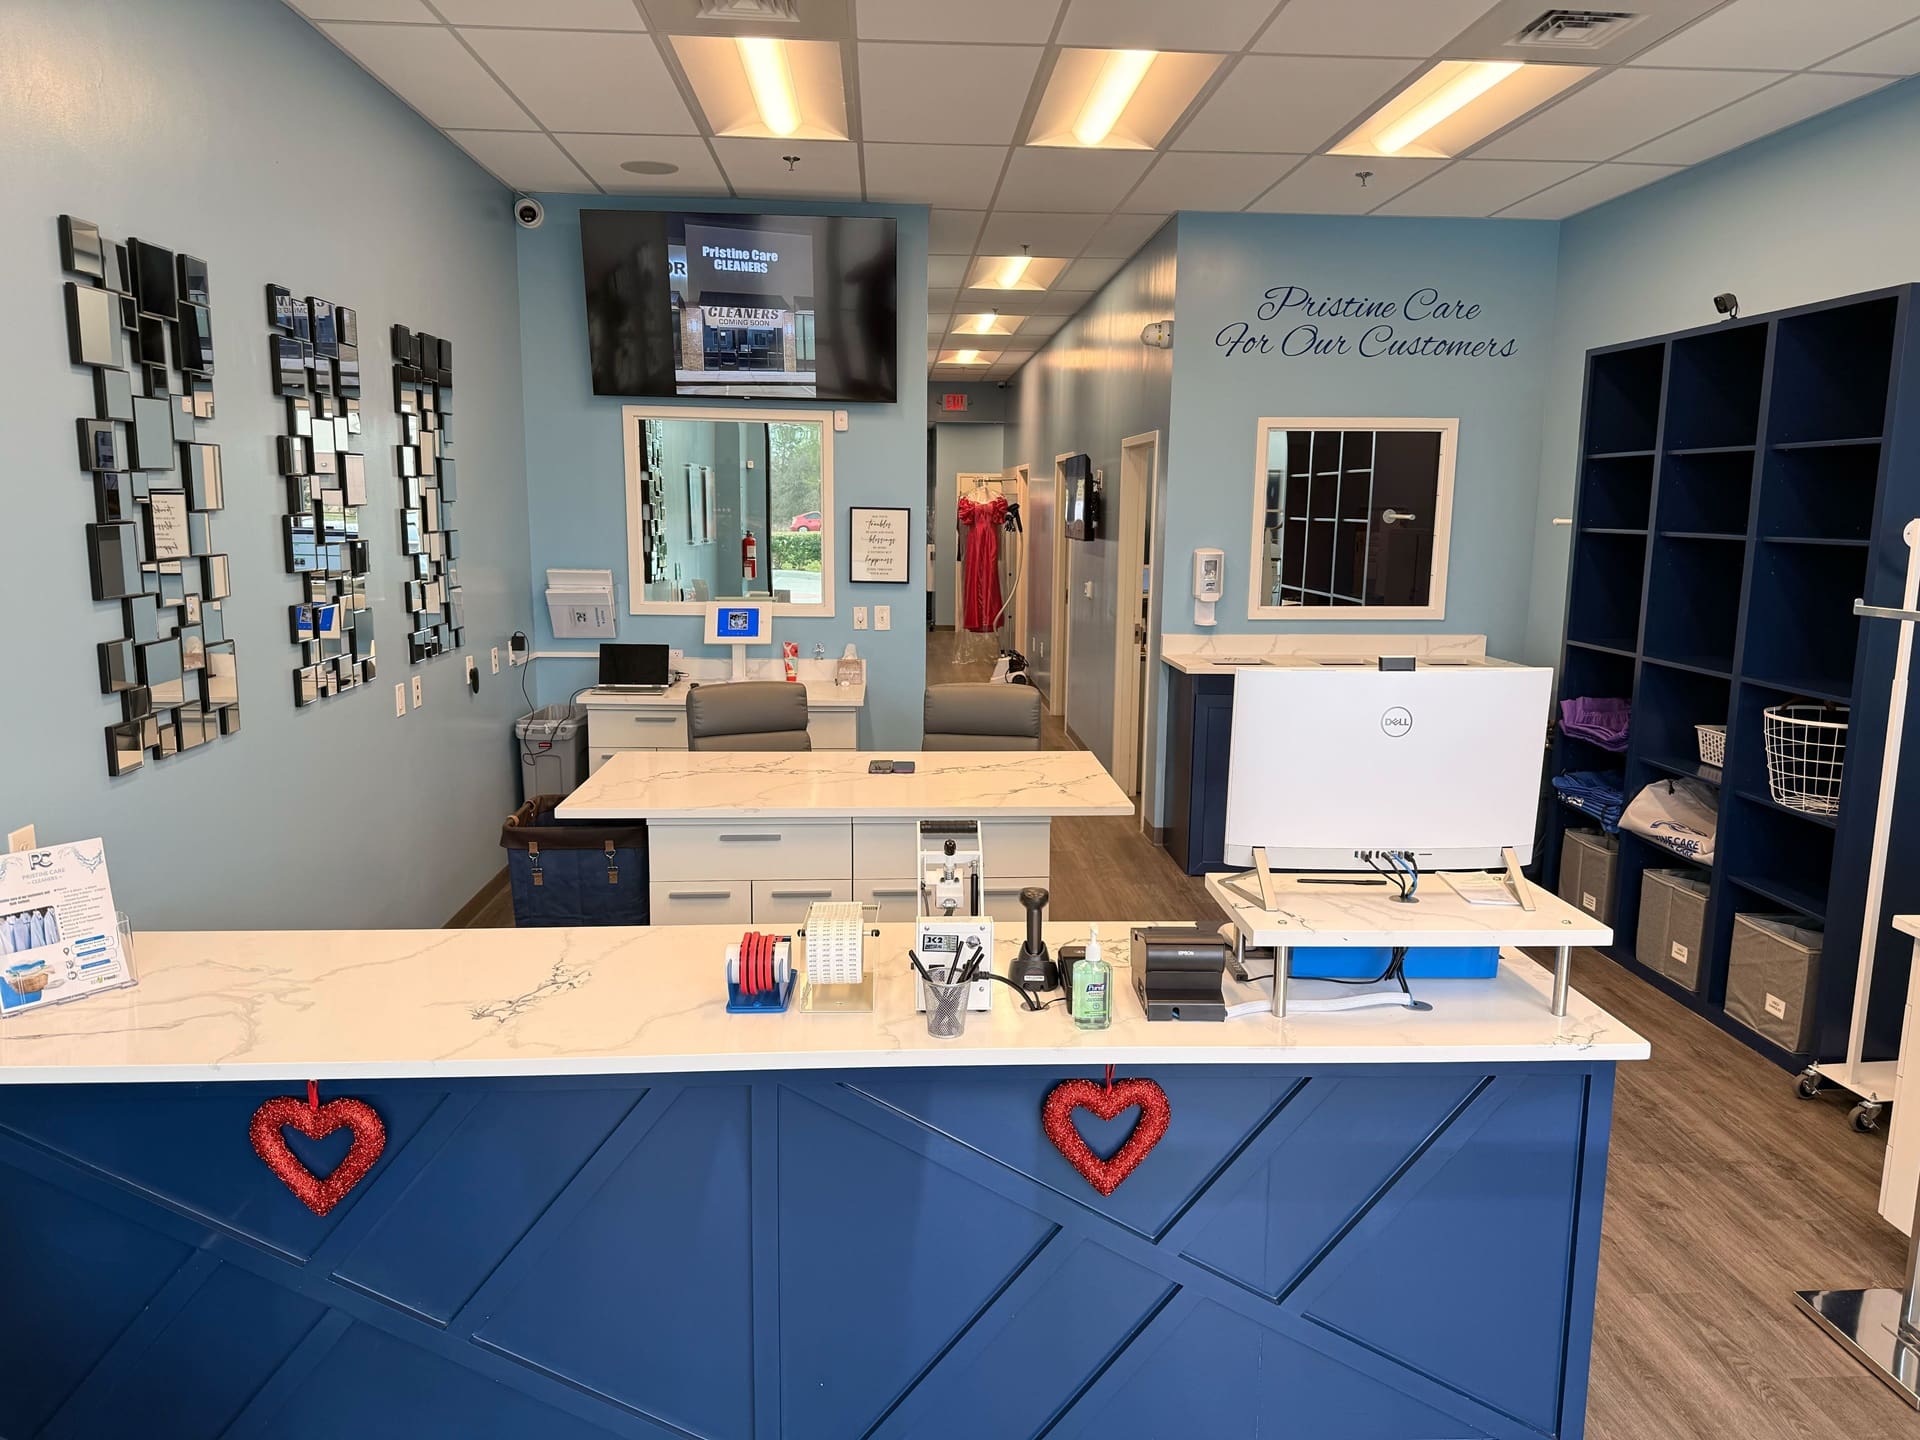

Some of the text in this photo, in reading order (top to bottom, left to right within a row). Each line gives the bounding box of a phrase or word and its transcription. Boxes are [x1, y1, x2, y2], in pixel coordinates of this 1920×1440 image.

[702, 246, 779, 262] Pristine Care
[714, 259, 768, 274] CLEANERS
[1257, 286, 1481, 321] Pristine Care
[709, 307, 779, 320] CLEANERS
[718, 318, 770, 327] COMING SOON
[1215, 322, 1518, 358] For Our Customers
[1385, 717, 1409, 726] DELL
